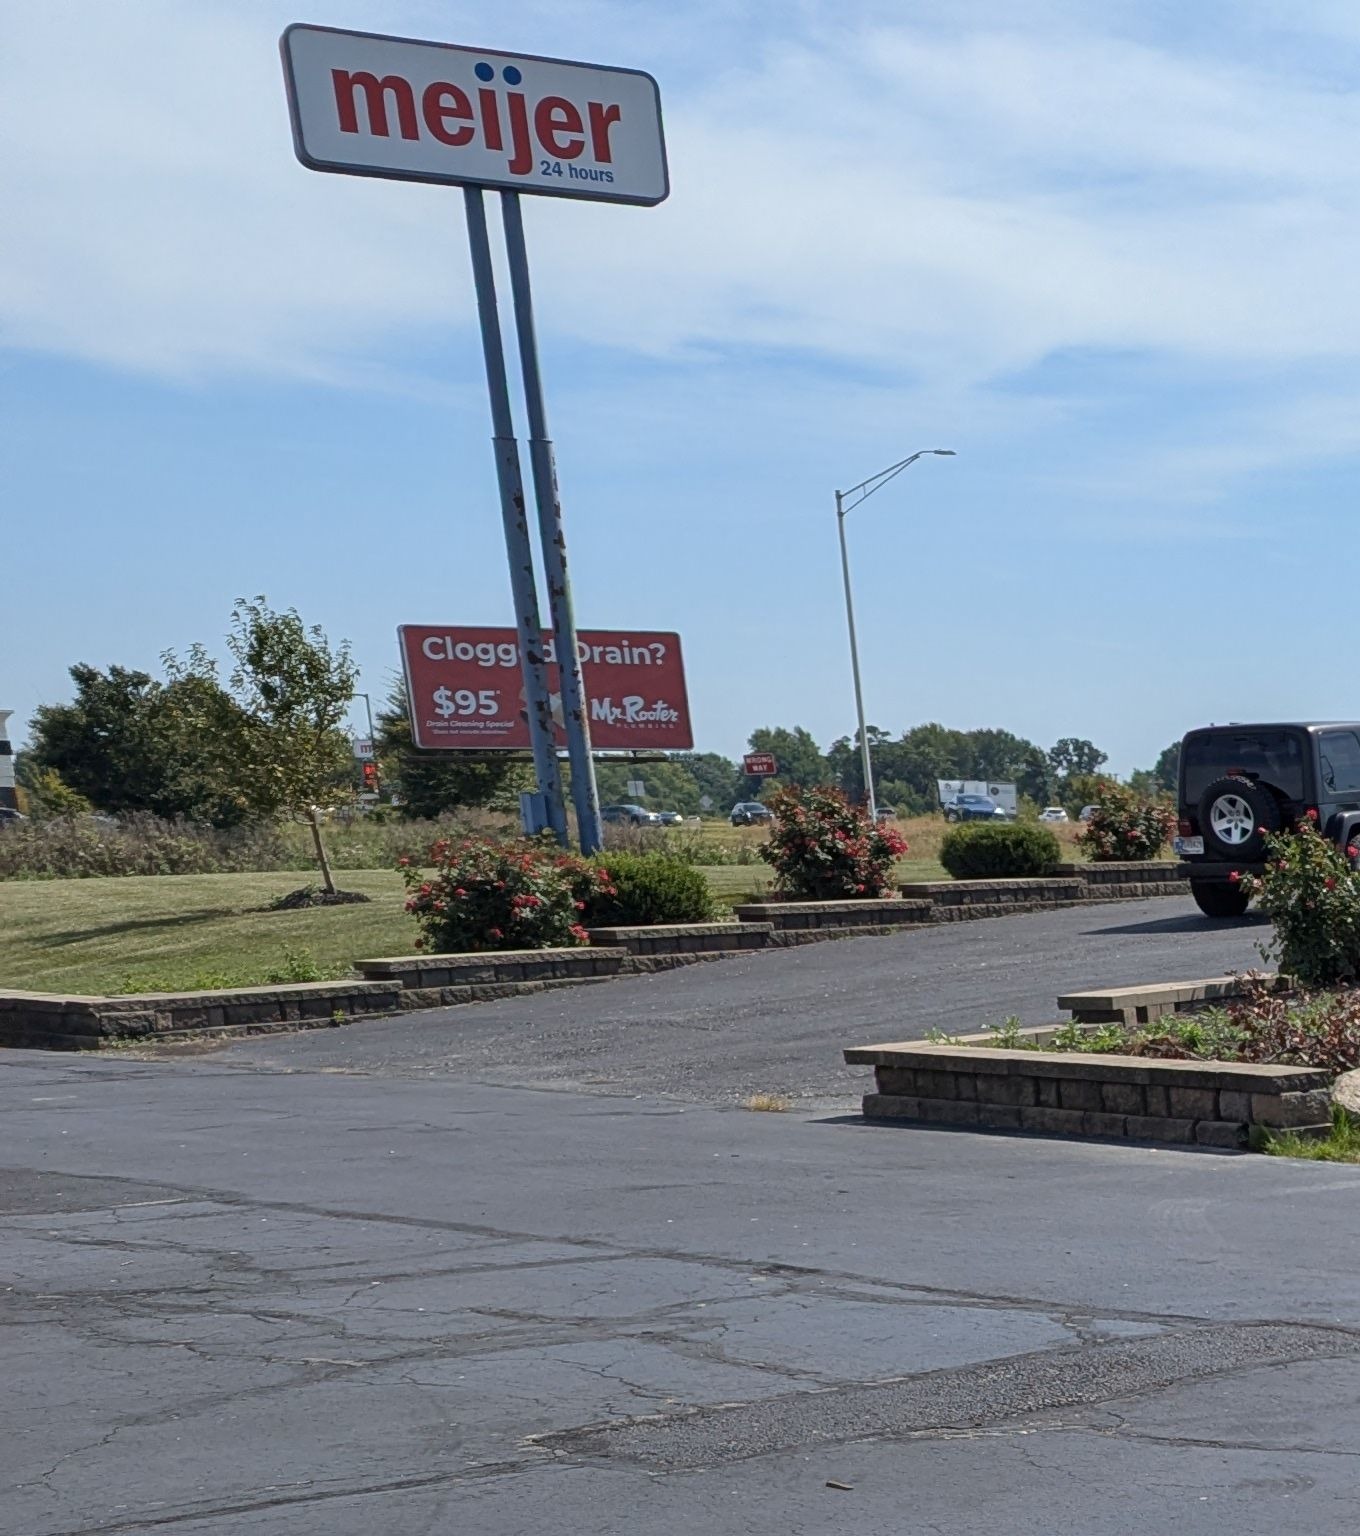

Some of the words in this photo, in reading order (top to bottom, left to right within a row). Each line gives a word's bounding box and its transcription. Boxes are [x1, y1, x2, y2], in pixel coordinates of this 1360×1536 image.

[331, 62, 621, 175] meijer
[540, 160, 563, 177] 24
[569, 163, 614, 183] hours
[422, 636, 557, 667] Cloggd
[622, 695, 678, 722] Rooter
